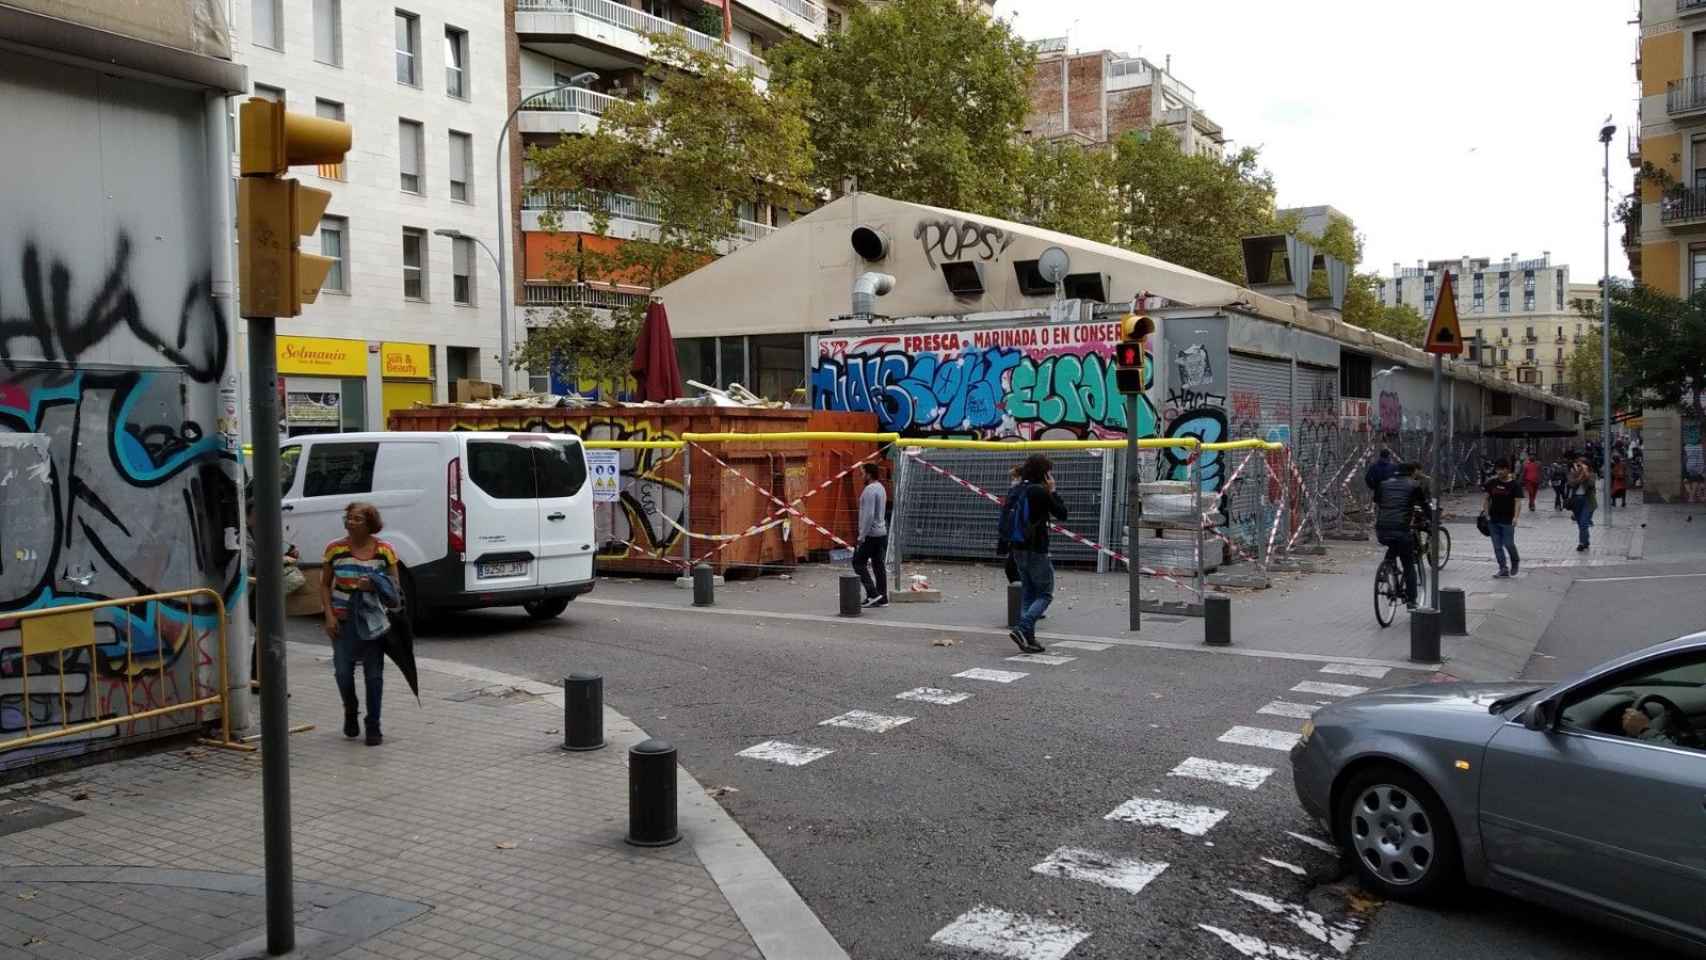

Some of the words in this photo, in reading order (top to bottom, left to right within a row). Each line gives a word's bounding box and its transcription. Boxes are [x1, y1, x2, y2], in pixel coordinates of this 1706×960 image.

[903, 333, 960, 352] FRESCA
[974, 329, 1038, 348] MARINADA
[1041, 327, 1049, 345] O
[1053, 326, 1070, 345] EN
